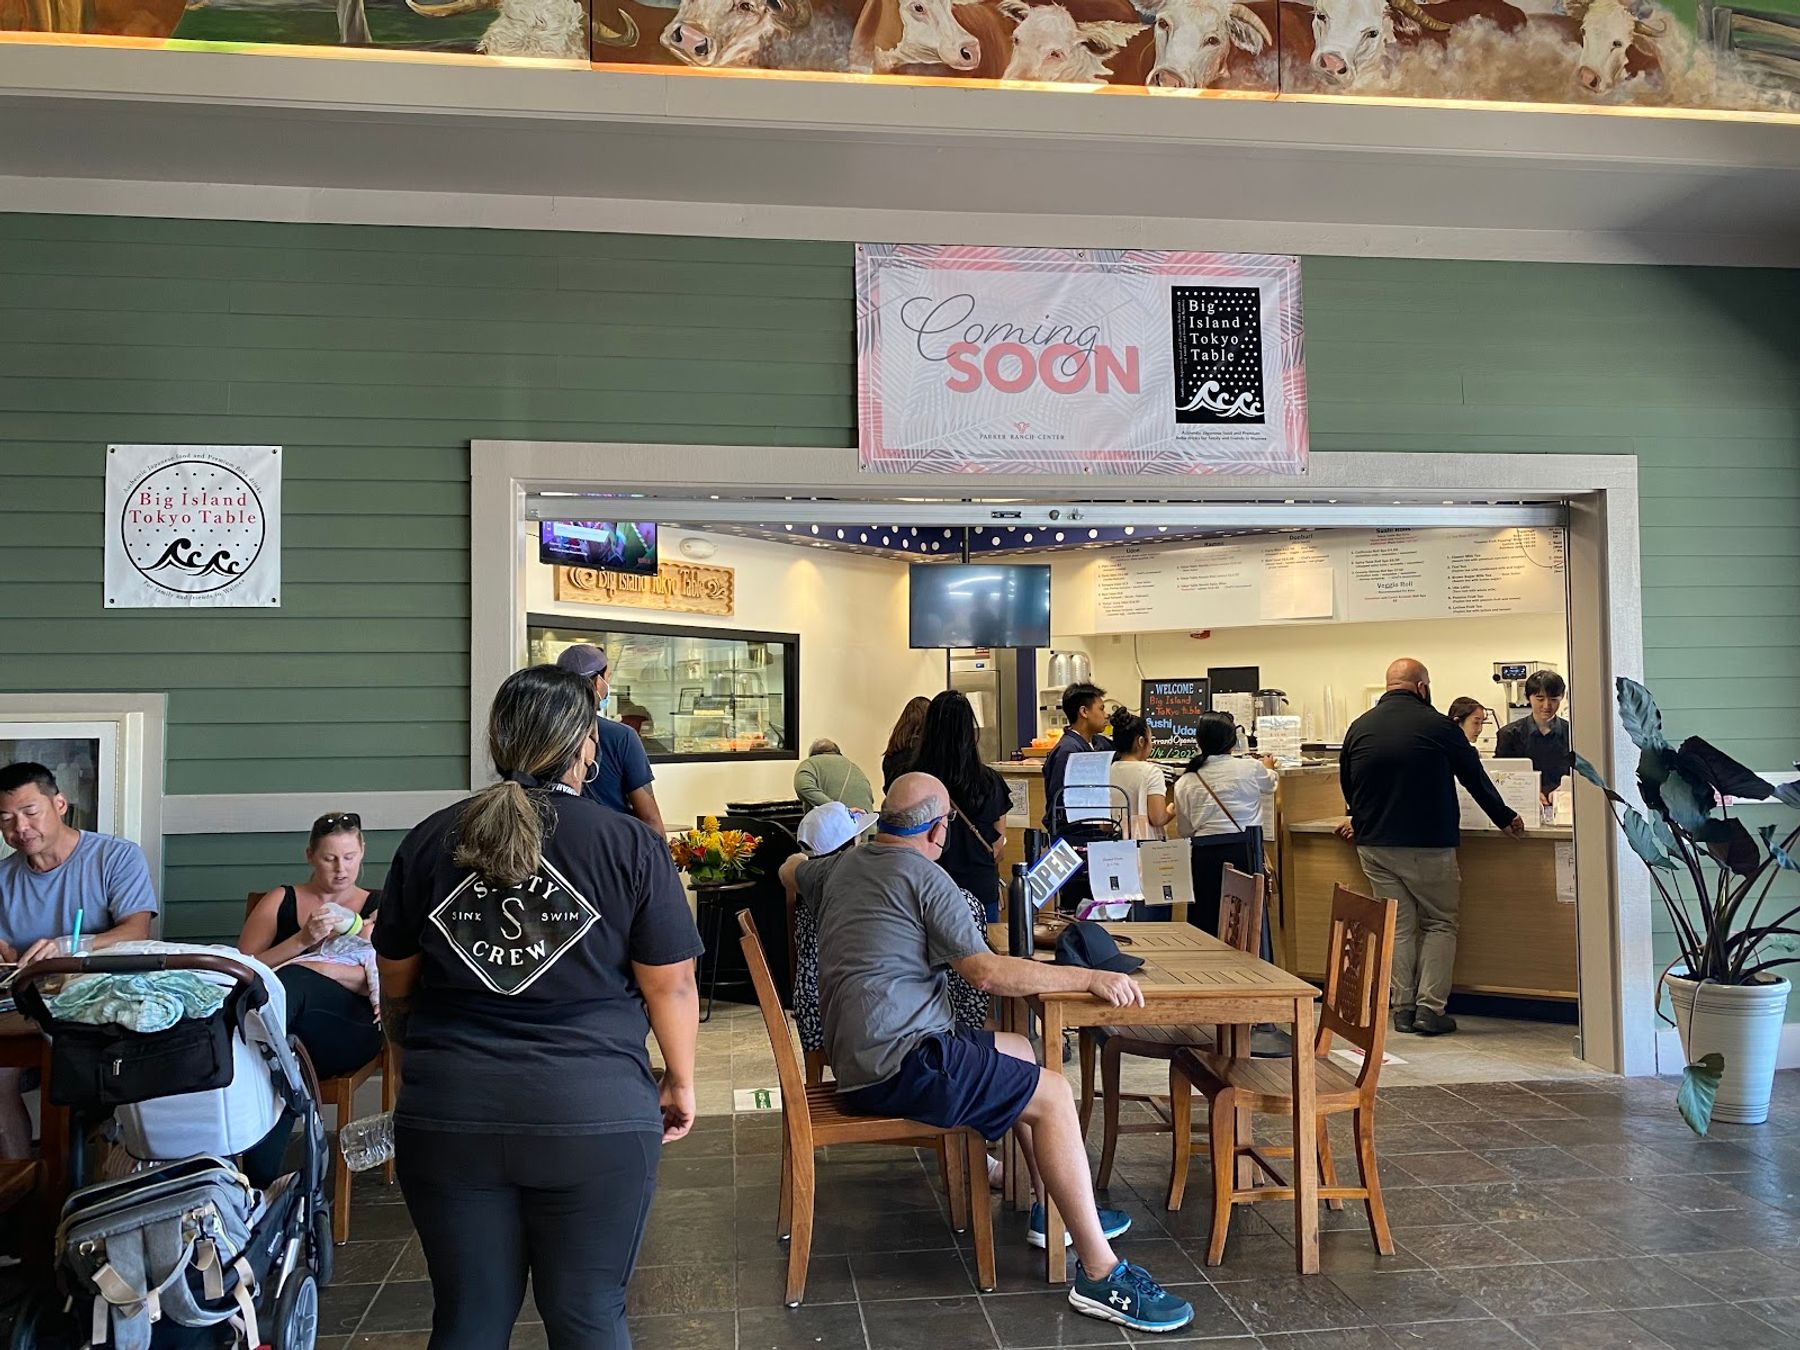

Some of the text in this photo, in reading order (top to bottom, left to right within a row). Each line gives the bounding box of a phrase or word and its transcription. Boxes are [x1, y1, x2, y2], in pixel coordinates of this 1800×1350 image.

[1189, 300, 1215, 315] Big
[1189, 316, 1241, 328] Island
[900, 294, 1100, 376] Coming
[1190, 333, 1239, 347] Tokyo
[1191, 349, 1235, 361] Table
[945, 341, 1140, 395] SOON
[140, 492, 247, 509] Big Island
[129, 510, 257, 527] Tokyo Table
[1156, 683, 1194, 695] WELCOME
[1149, 696, 1191, 707] Big Island
[1146, 717, 1173, 729] Sushi
[1027, 845, 1078, 900] OPEN
[473, 876, 560, 899] STY
[451, 911, 482, 922] SINK
[541, 911, 579, 922] SWIM
[472, 940, 547, 967] CREW
